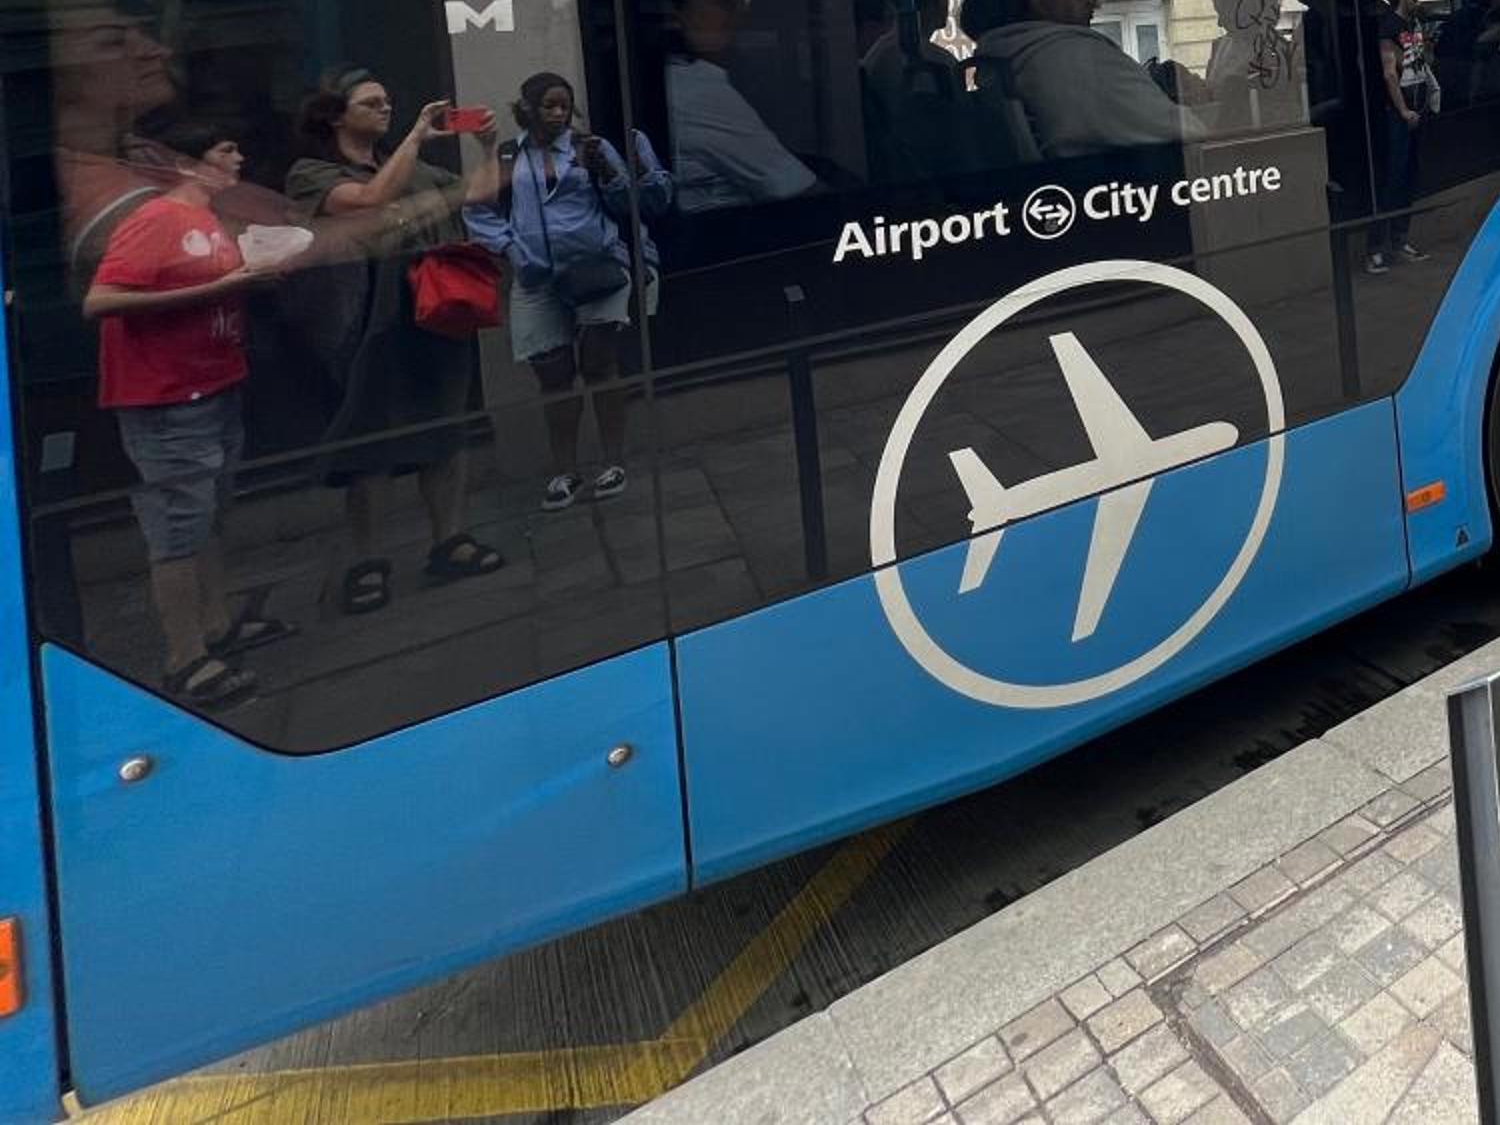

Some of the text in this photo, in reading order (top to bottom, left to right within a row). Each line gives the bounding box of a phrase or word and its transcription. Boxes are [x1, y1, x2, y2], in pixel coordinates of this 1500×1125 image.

[833, 165, 1281, 263] Airport City centre
